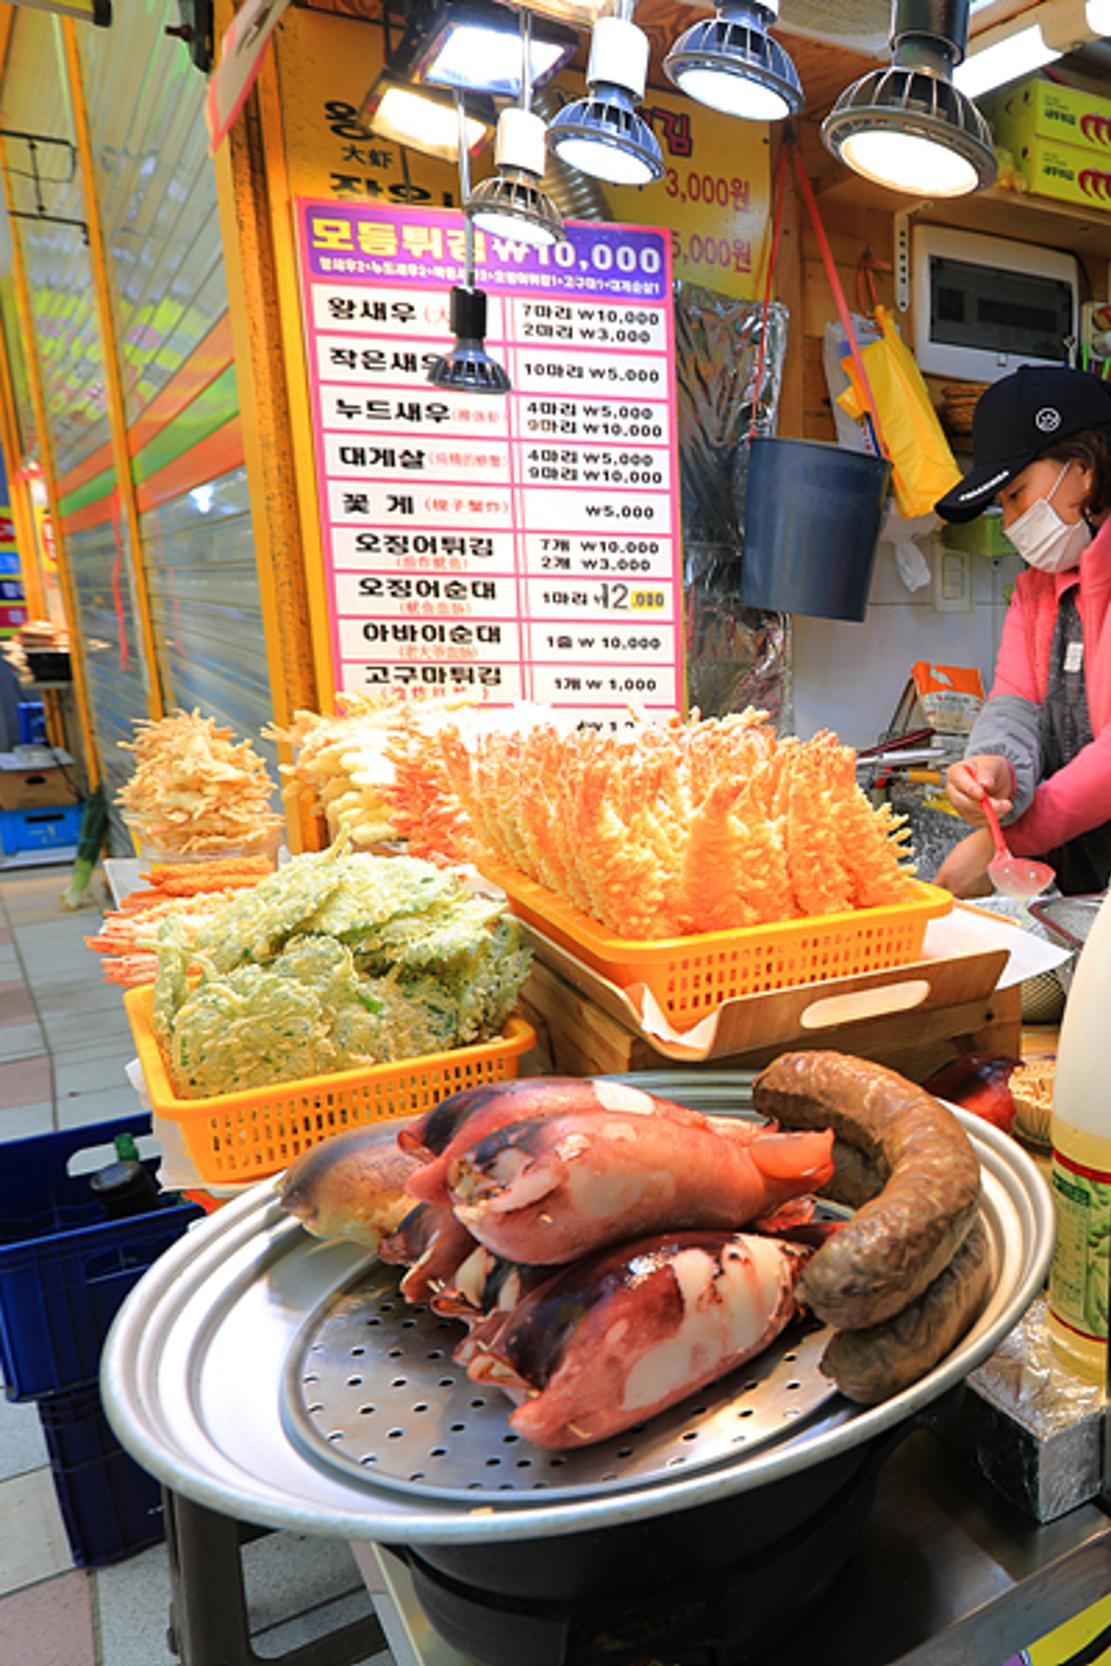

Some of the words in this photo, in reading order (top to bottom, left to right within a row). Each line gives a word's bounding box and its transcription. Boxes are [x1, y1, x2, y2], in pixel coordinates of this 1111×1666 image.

[312, 217, 487, 262] 모듬튀김
[328, 297, 416, 323] 왕새우
[522, 303, 572, 320] 7마리
[523, 323, 573, 340] 2마리
[525, 363, 584, 379] 10마리
[336, 399, 451, 424] 누드새우
[527, 402, 577, 417] 4마리
[527, 419, 577, 434] 9마리
[339, 446, 425, 469] 대게살
[527, 449, 579, 464] 4마리
[528, 466, 579, 481] 9마리
[355, 533, 494, 557] 오징어튀김
[540, 538, 571, 552] 7개
[541, 556, 571, 569] 2개
[358, 577, 497, 600] 오징어순대
[542, 591, 588, 605] 1마리
[363, 622, 501, 645] 아바이순대
[365, 666, 502, 687] 고구마튀김
[554, 677, 581, 690] 1개
[609, 679, 657, 691] 1,000
